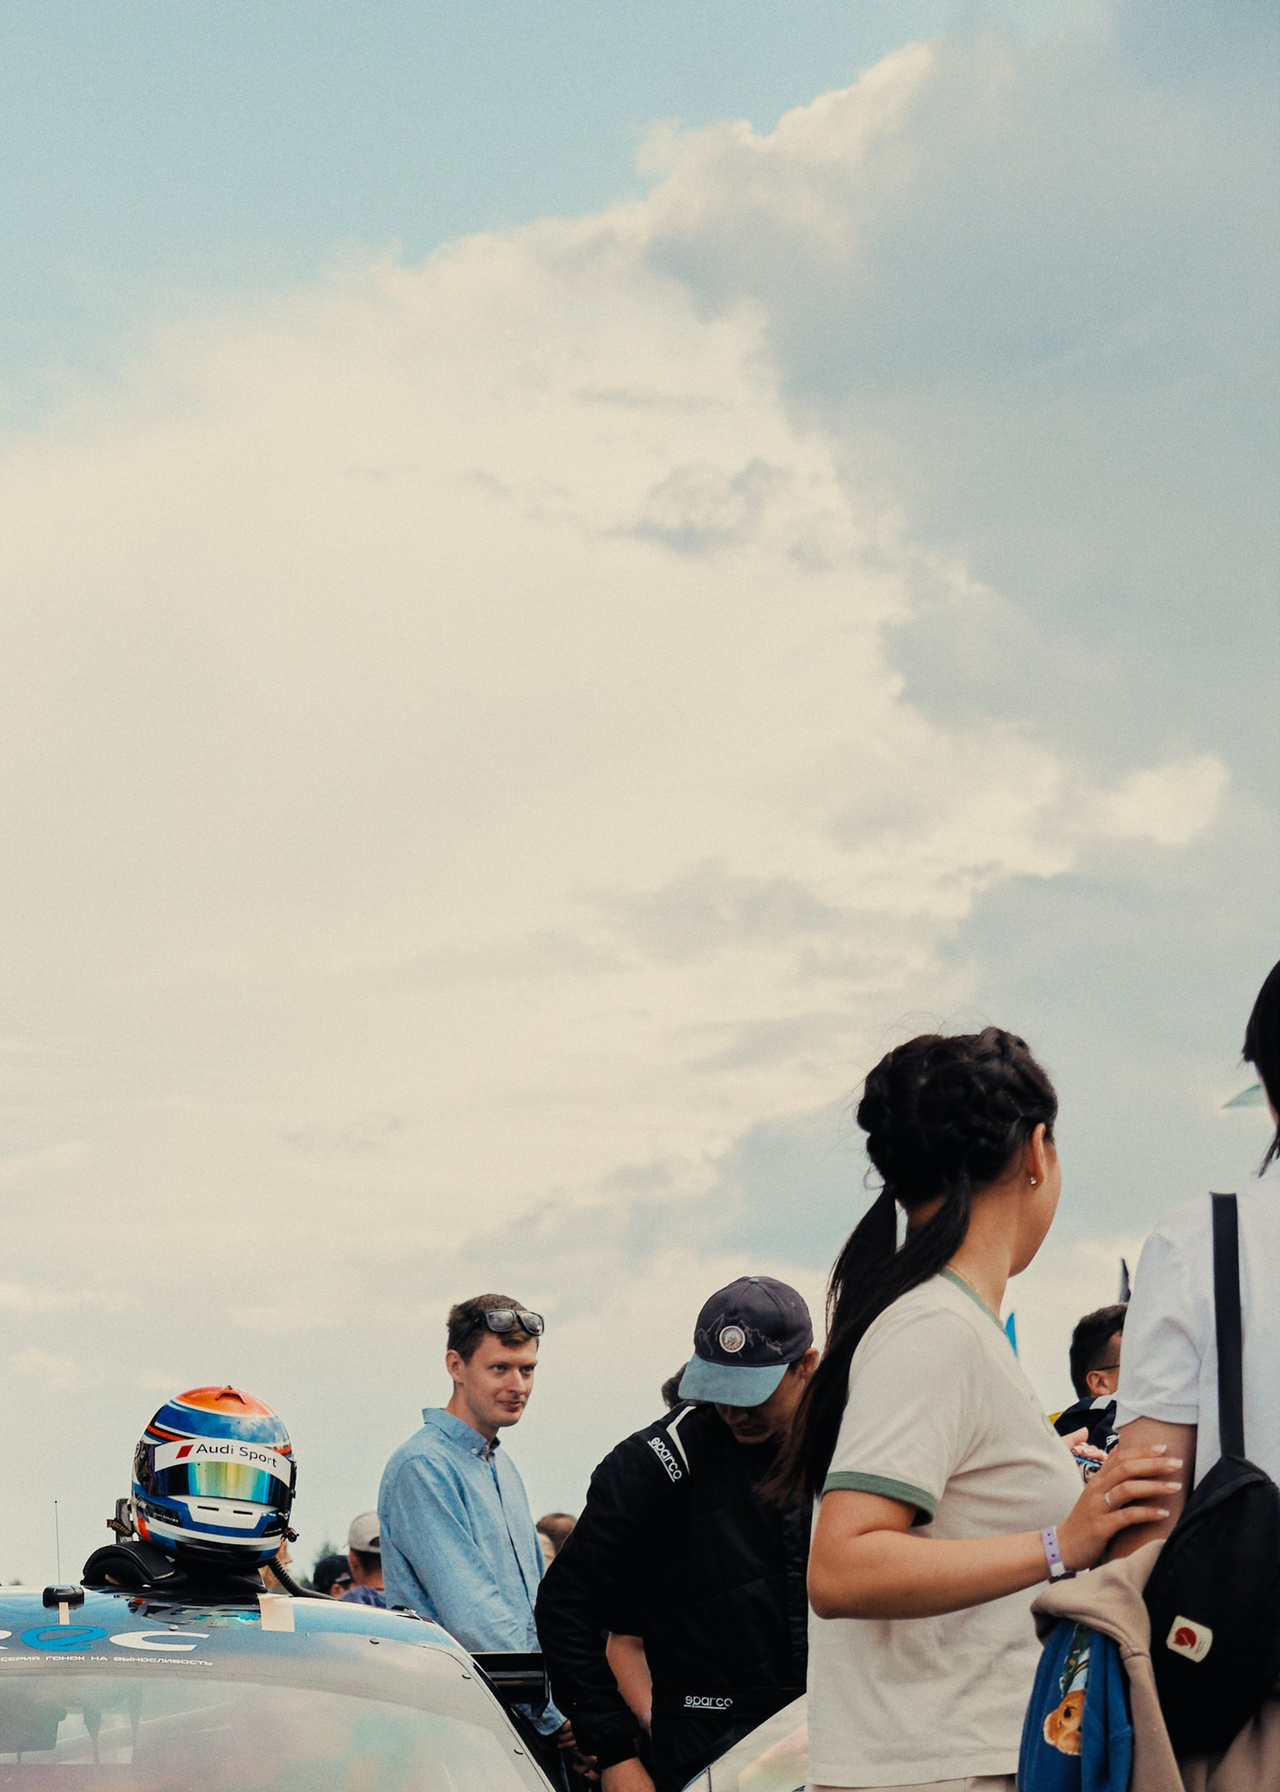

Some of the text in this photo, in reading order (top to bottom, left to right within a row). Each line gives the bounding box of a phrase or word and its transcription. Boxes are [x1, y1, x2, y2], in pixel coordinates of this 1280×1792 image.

[196, 1444, 277, 1468] Audi Sport
[647, 1437, 682, 1482] sparco
[114, 1656, 213, 1666] ВЫНОСЛИВОСТЬ
[683, 1695, 733, 1710] sparco
